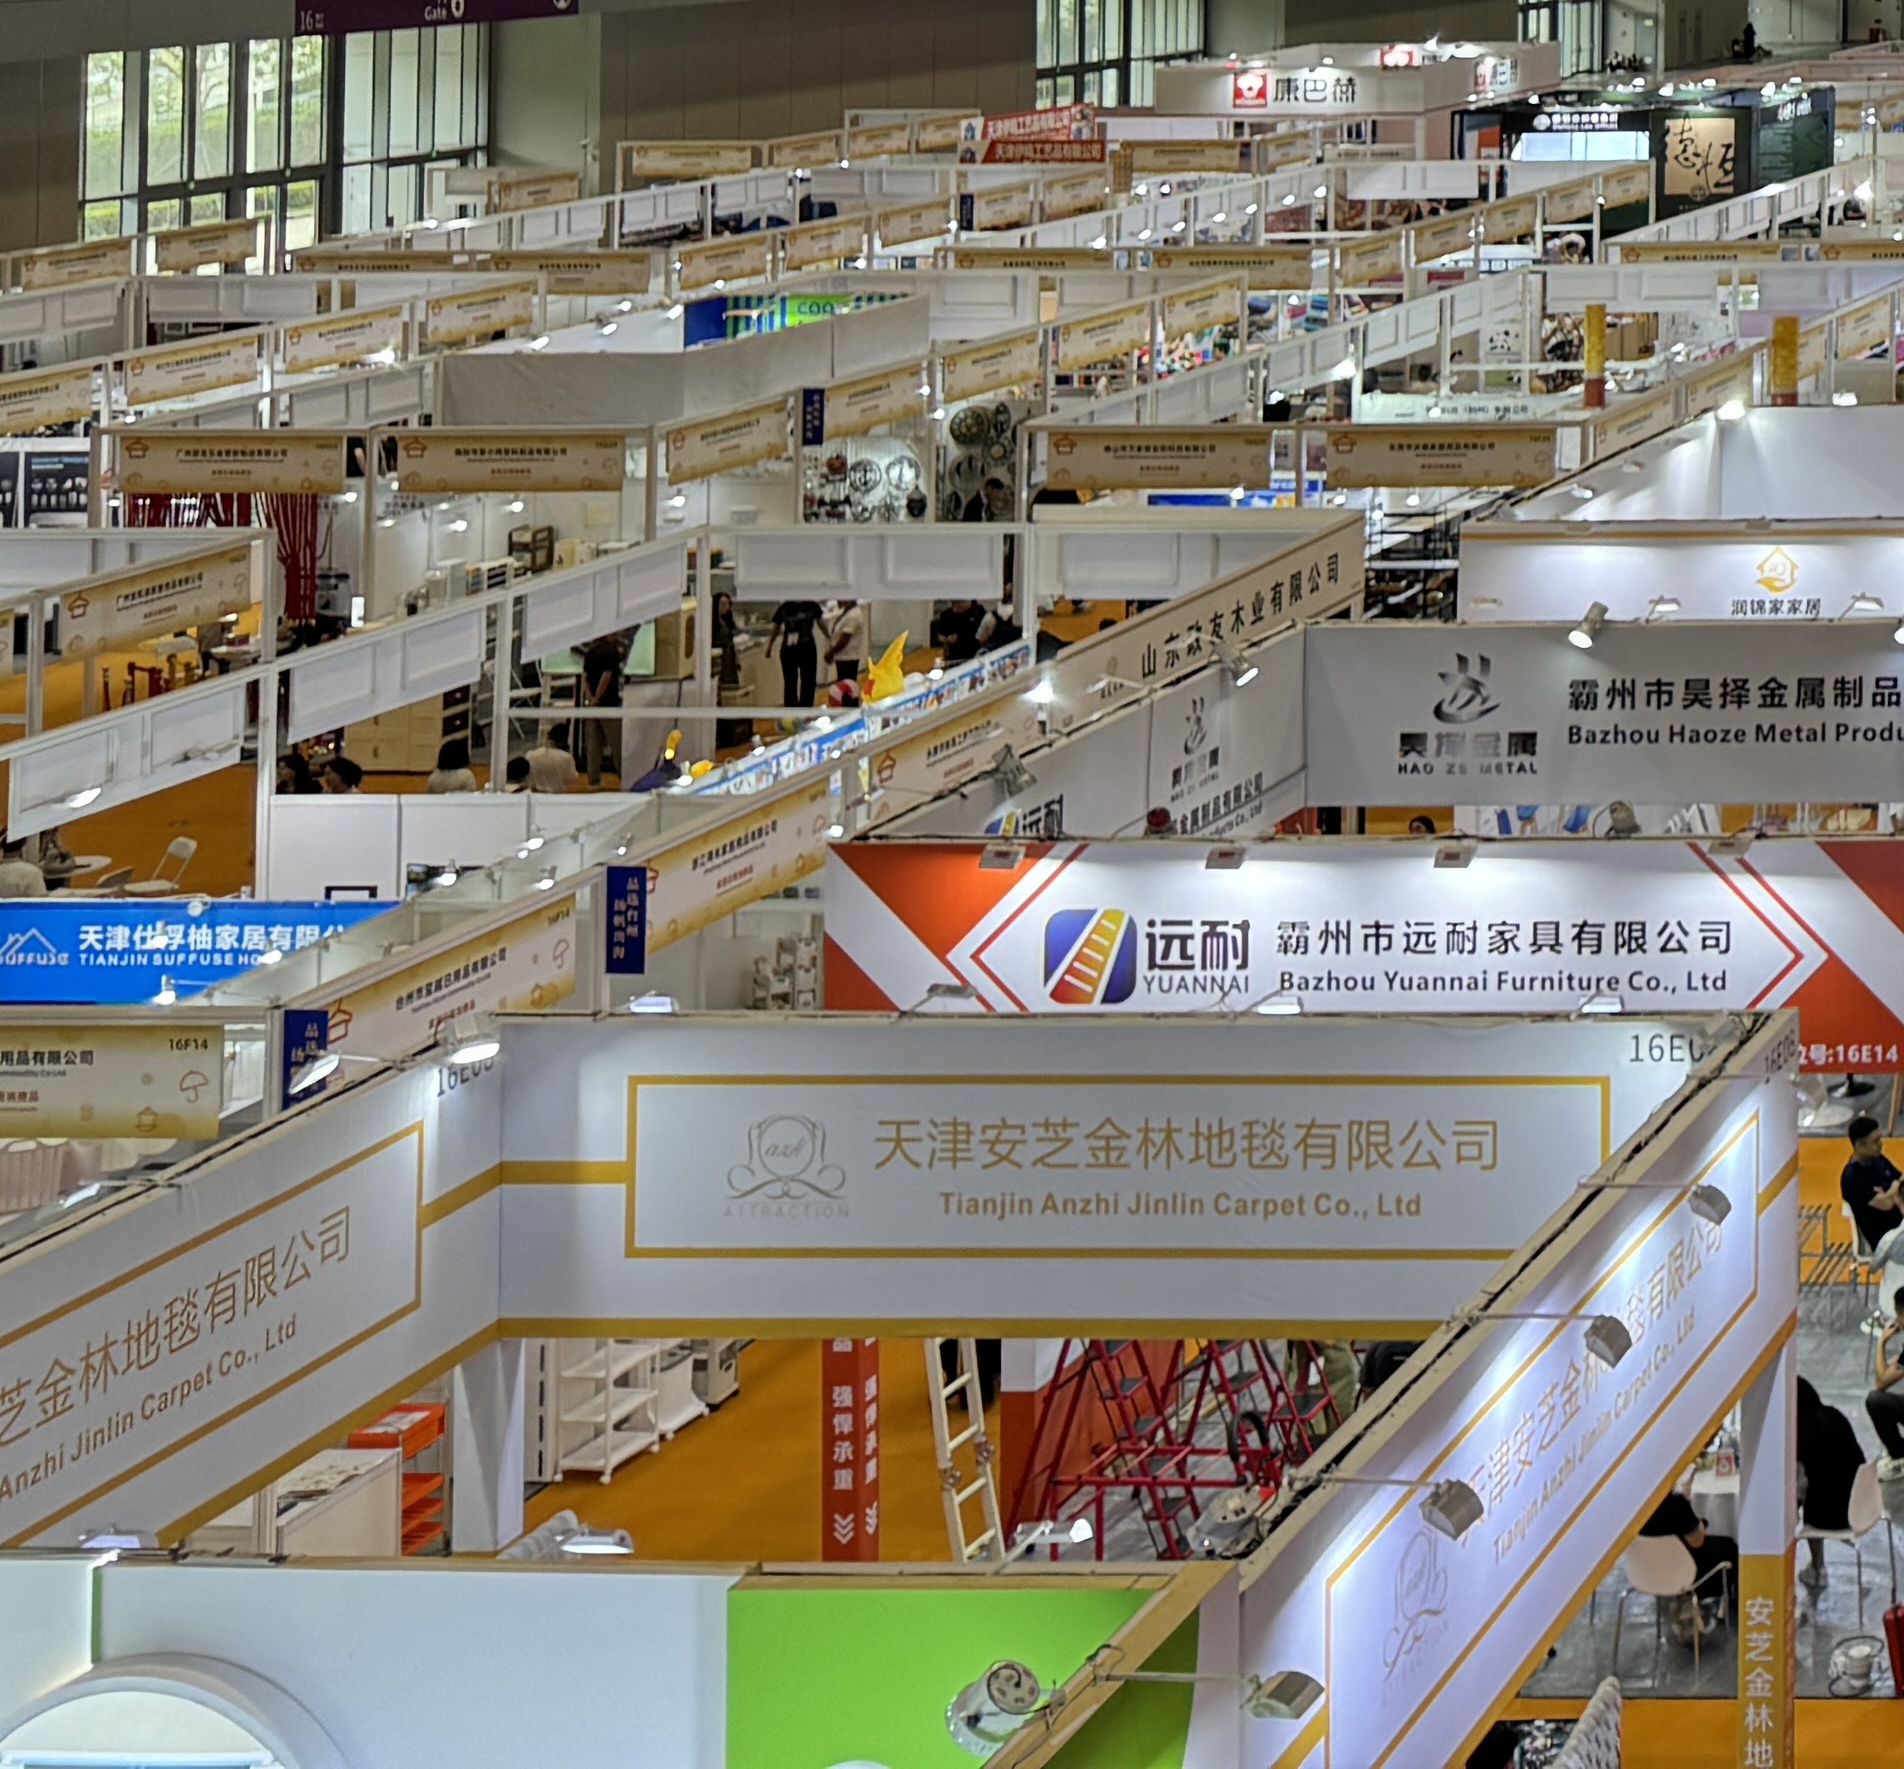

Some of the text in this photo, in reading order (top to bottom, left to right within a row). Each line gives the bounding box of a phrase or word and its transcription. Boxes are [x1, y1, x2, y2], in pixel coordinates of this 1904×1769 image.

[1273, 76, 1357, 105] 康巴赫
[1568, 724, 1661, 745] Bazhou
[1668, 723, 1748, 745] Haoze
[1754, 722, 1828, 744] Metal
[1397, 762, 1434, 776] HAO
[1478, 761, 1539, 776] METAL
[1146, 918, 1732, 972] 远耐 霸州市远耐家具有限公司
[79, 954, 235, 968] TIANJIN SUFFUSE
[1143, 974, 1249, 995] YUANNAI
[1279, 969, 1727, 997] Bazhou Yuannai Furniture Co., Ltd
[167, 1038, 209, 1052] 16F14
[875, 1116, 1501, 1172] 天津安芝金林地毯有限公司
[938, 1190, 1422, 1221] Tianjin Anzhi Jinlin Carpet Co., Ltd
[69, 1407, 134, 1464] Jinlin
[140, 1366, 214, 1423] Carpet
[218, 1347, 259, 1382] Co.,
[263, 1317, 298, 1367] Ltd
[1744, 1595, 1776, 1769] 安芝金林地
